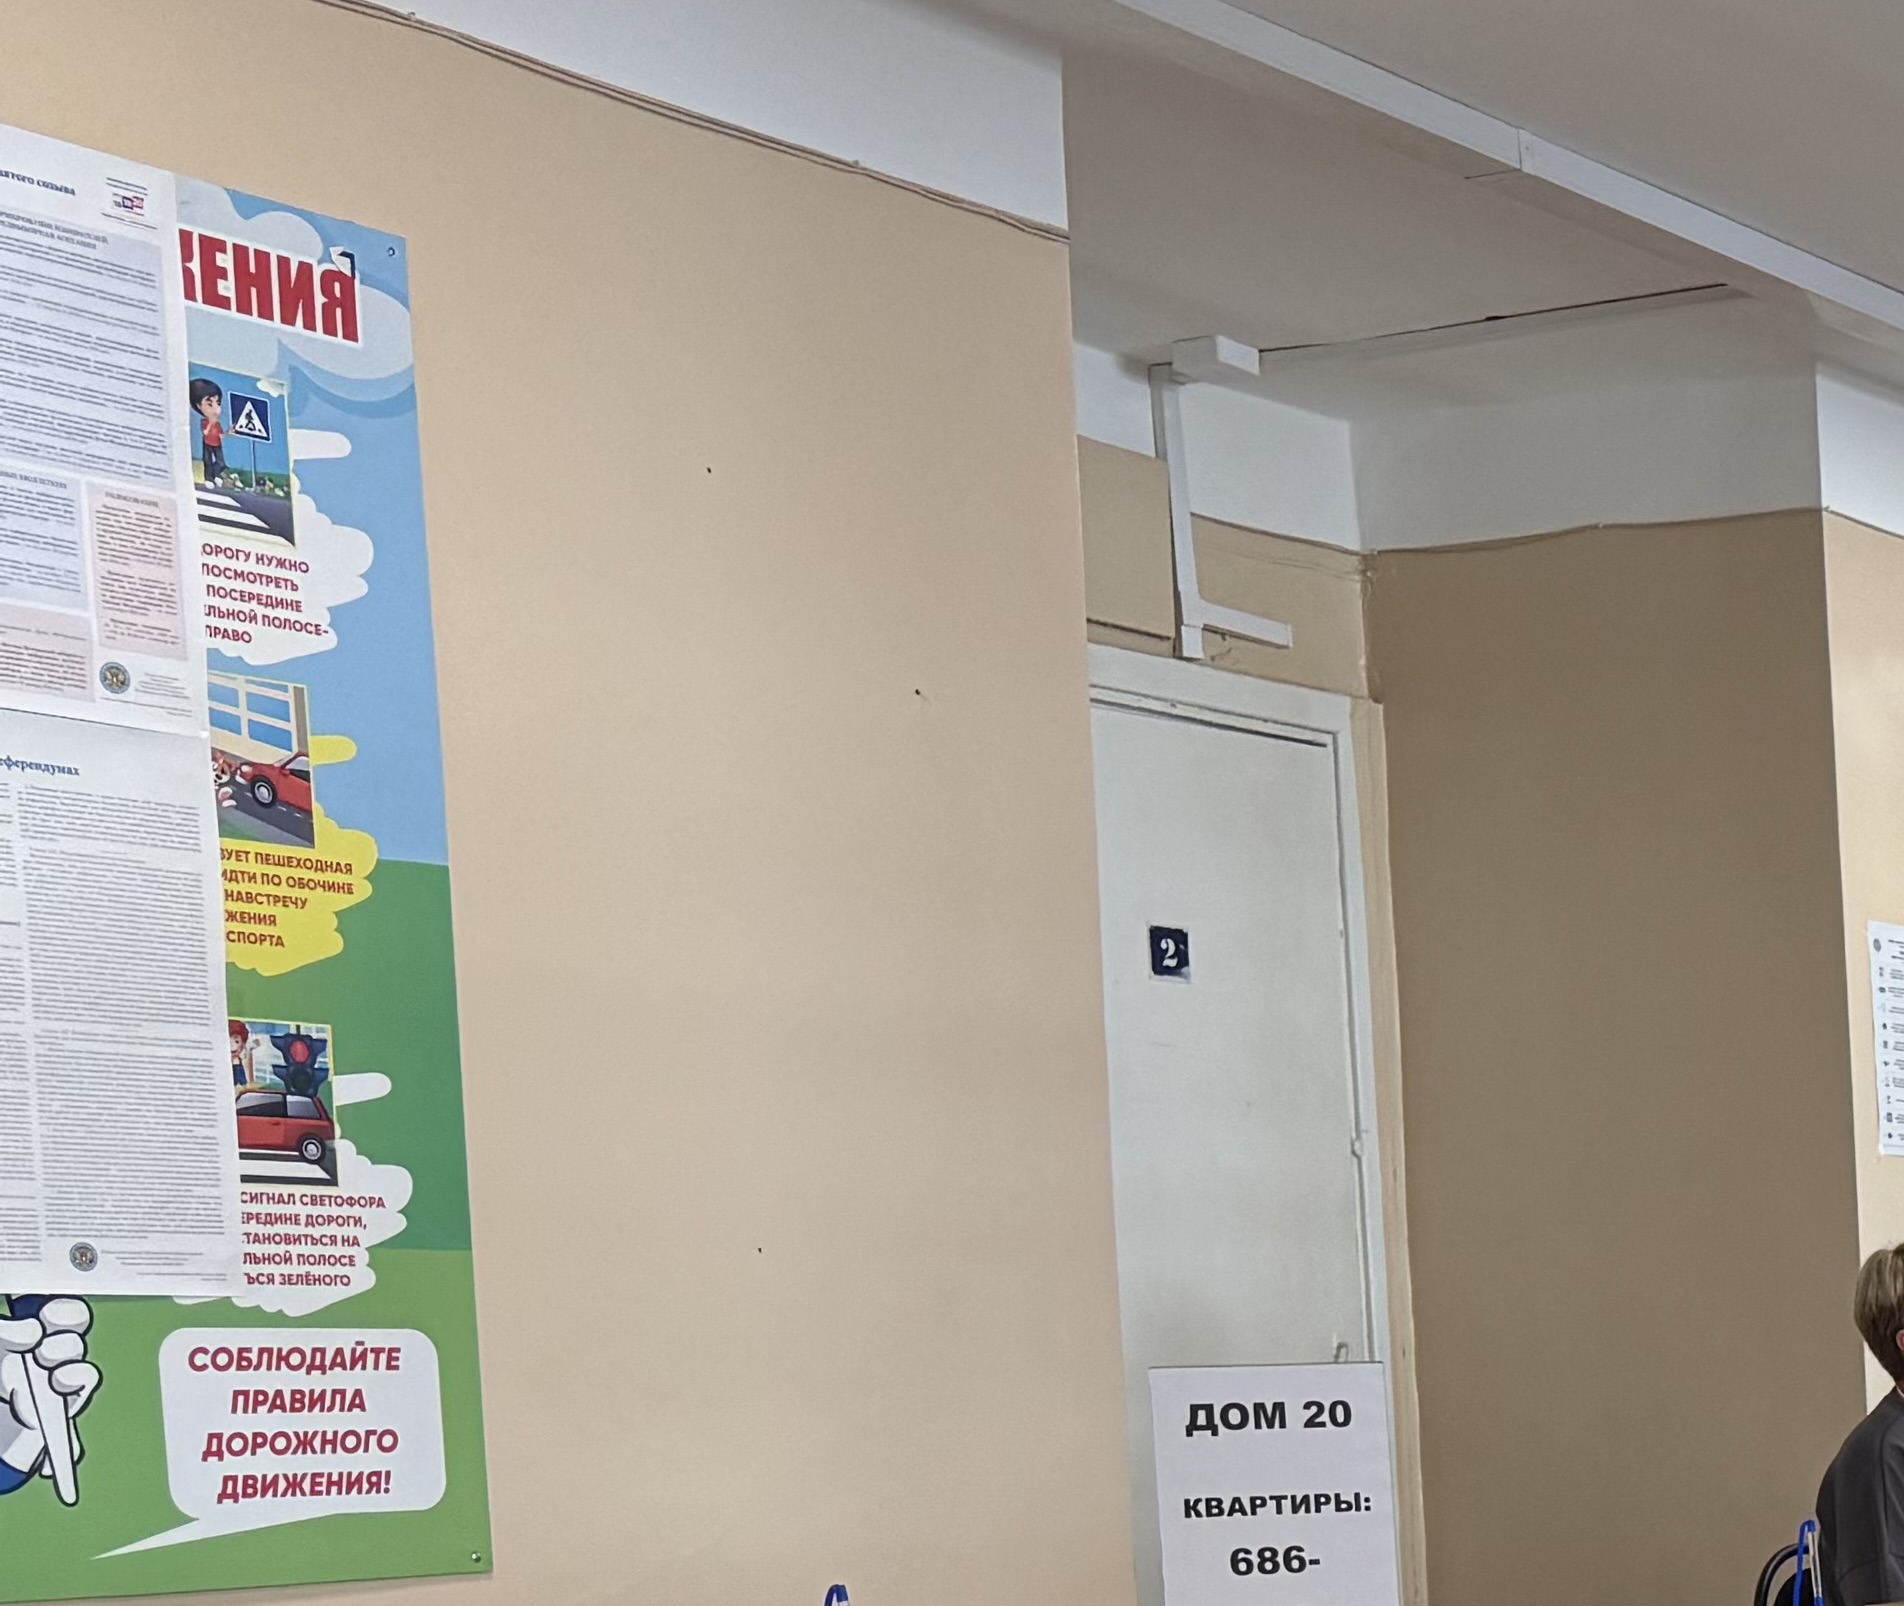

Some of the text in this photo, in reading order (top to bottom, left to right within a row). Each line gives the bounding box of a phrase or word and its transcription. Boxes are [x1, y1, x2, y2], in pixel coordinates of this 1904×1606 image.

[201, 543, 309, 573] ОРОГУ НУЖНО
[202, 563, 298, 592] ПОСМОТРЕТЬ
[206, 584, 303, 613] ПОСЕРЕДИНЕ
[262, 614, 328, 636] ПОЛОСЕ-
[254, 852, 352, 875] ПЕШЕХОДНАЯ
[261, 872, 282, 887] ПО
[286, 876, 354, 895] ОБОЧИНЕ
[224, 888, 308, 910] НАВСТРЕЧУ
[226, 930, 286, 948] СПОРТА
[1160, 938, 1178, 967] 2
[240, 1191, 386, 1208] СИГНАЛ СВЕТОФОРА
[304, 1214, 367, 1230] ДОРОГИ,
[242, 1232, 361, 1248] ТАНОВИТЬСЯ НА
[242, 1250, 294, 1266] ЛЬНОЙ
[296, 1254, 356, 1267] ПОЛОСЕ
[278, 1272, 351, 1287] ЗЕЛЁНОГО
[188, 1341, 401, 1375] СОБЛЮДАЙТЕ
[230, 1388, 367, 1414] ПРАВИЛА
[1186, 1400, 1352, 1437] ДОМ 20
[201, 1429, 398, 1462] ДОРОЖНОГО
[216, 1470, 392, 1504] ДВИЖЕНИЯ!
[1184, 1492, 1372, 1518] КВАРТИРЫ:
[1230, 1546, 1320, 1576] 686-
